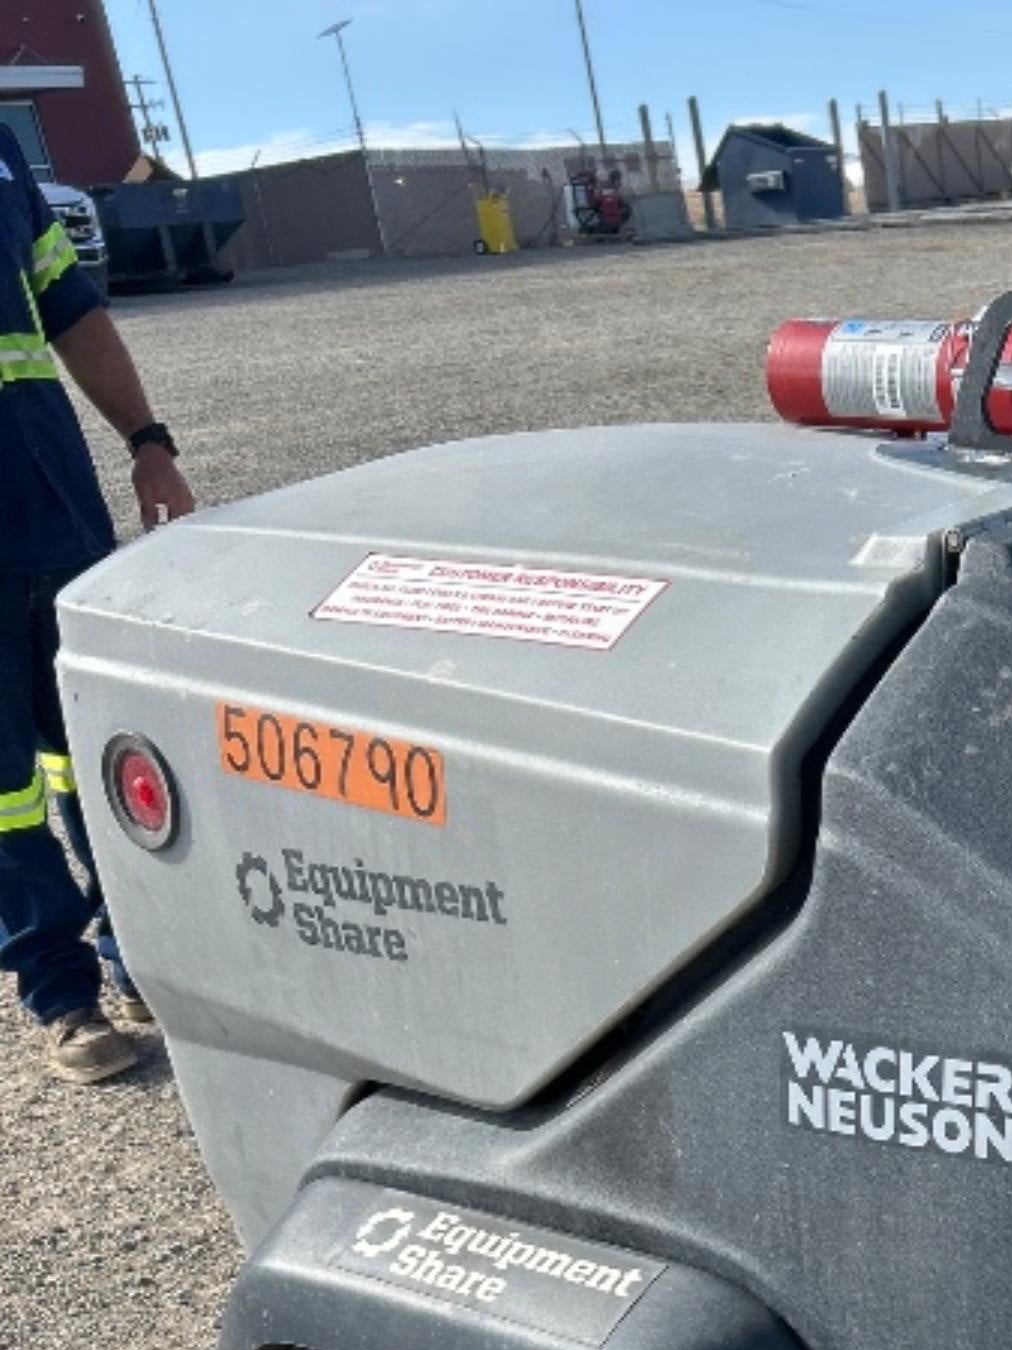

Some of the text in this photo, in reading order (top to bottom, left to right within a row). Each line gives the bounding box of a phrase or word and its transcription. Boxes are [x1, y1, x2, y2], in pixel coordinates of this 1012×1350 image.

[428, 565, 514, 587] CUSTOMER
[514, 571, 648, 597] RESPONSIBILITY
[223, 706, 441, 818] 506790
[280, 847, 508, 926] Equipment
[293, 901, 409, 962] Share
[389, 1243, 507, 1303] Share
[418, 1210, 643, 1298] Equipment
